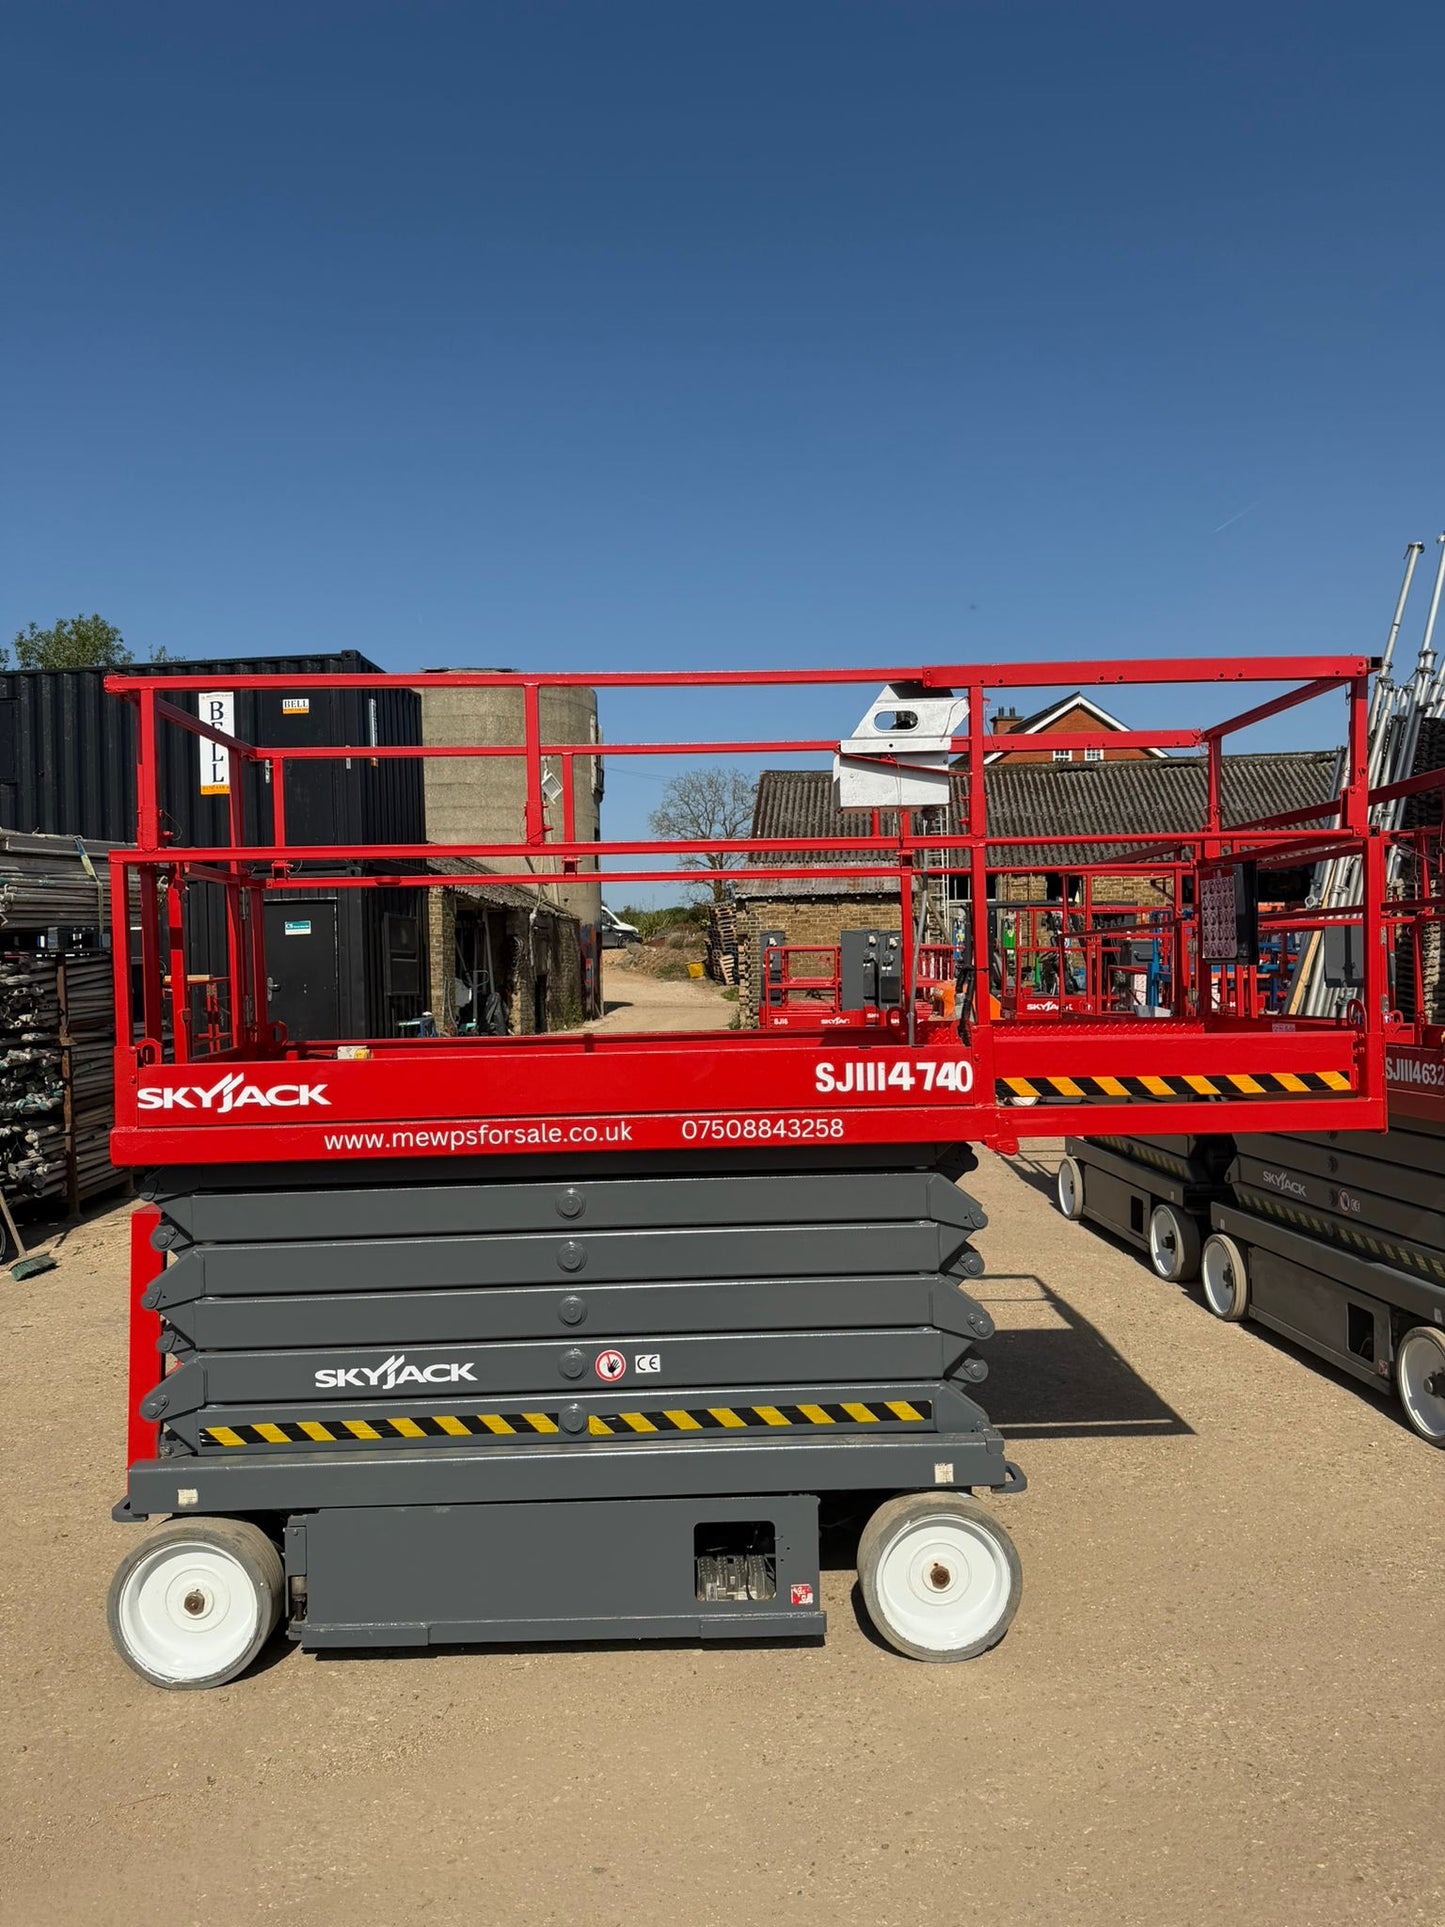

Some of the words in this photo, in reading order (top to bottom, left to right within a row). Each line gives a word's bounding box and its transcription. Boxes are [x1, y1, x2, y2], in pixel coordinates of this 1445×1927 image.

[137, 1072, 332, 1113] SKYJACK
[324, 1121, 632, 1150] www.mewpsforsale.co.uk
[682, 1118, 844, 1139] 07508843258
[1263, 1170, 1307, 1197] SKYJACK
[315, 1354, 478, 1389] SKYJACK
[637, 1355, 658, 1371] CE
